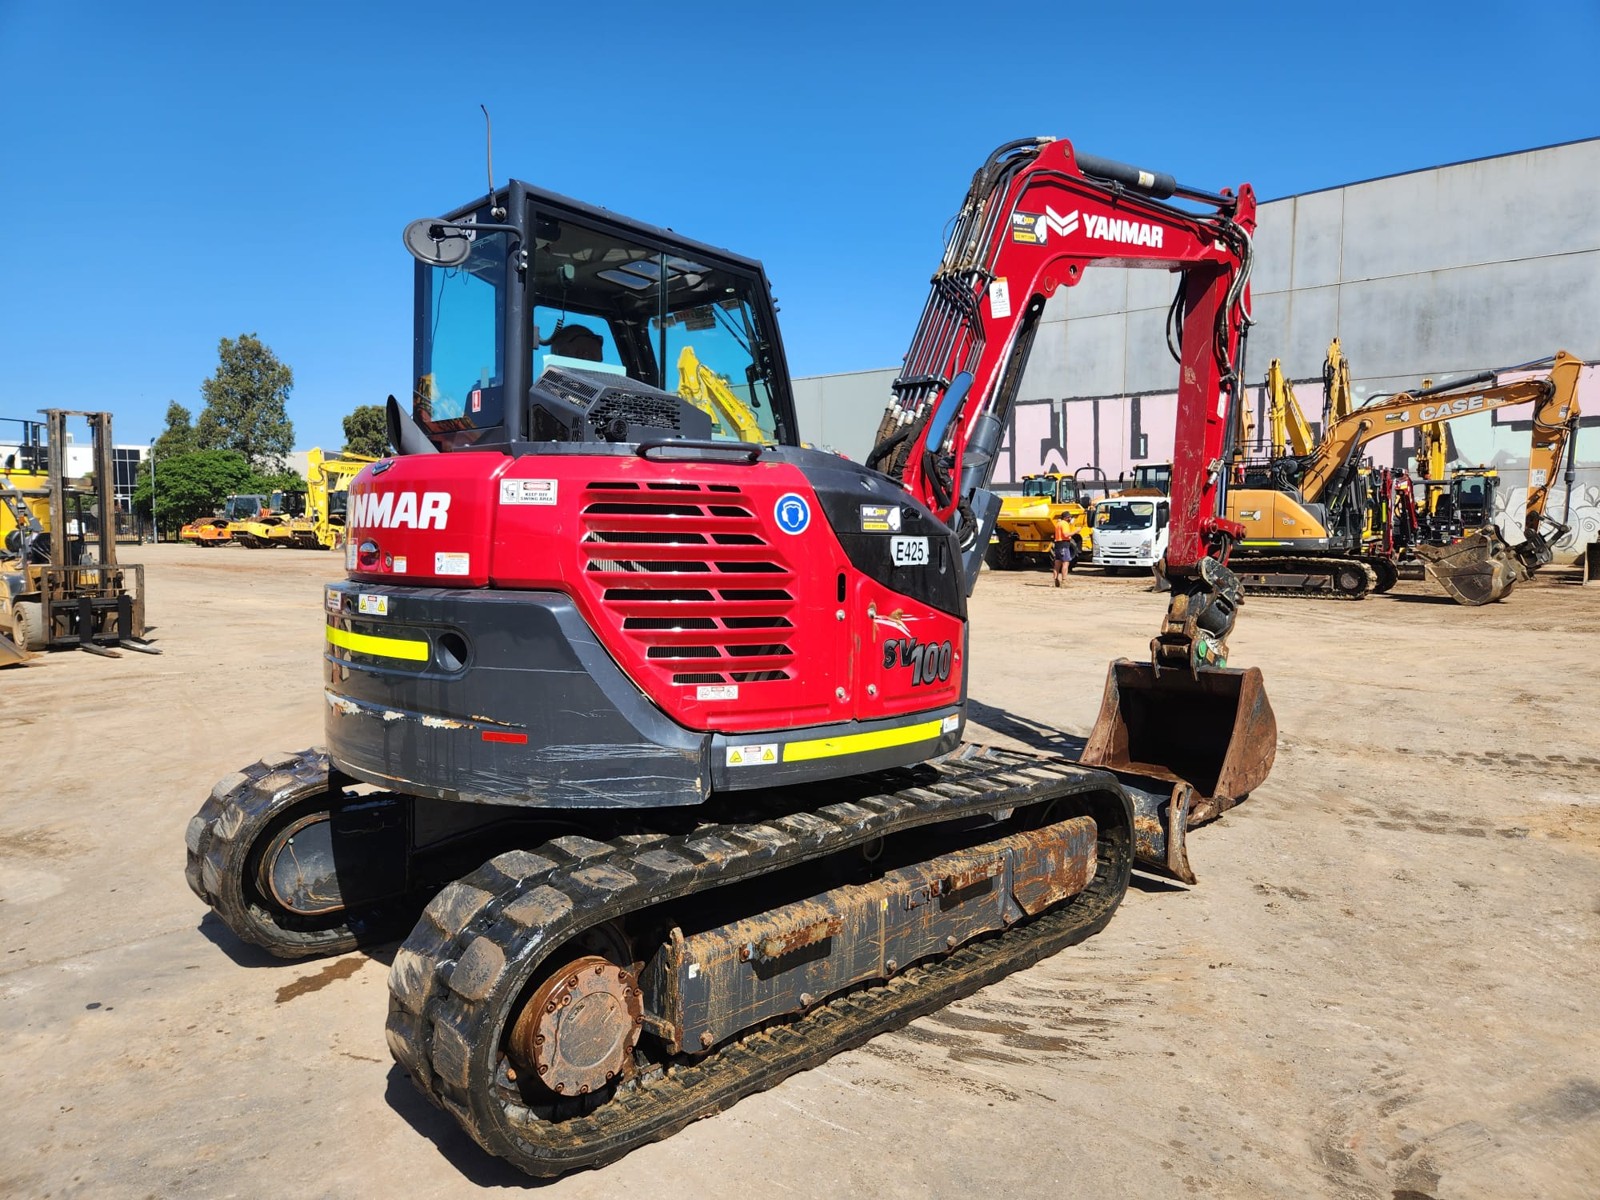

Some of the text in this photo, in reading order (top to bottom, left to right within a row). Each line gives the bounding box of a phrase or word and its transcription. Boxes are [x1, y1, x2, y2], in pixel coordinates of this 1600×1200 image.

[1082, 213, 1163, 248] YANMAR
[1419, 395, 1484, 421] CASE
[896, 541, 924, 561] E425
